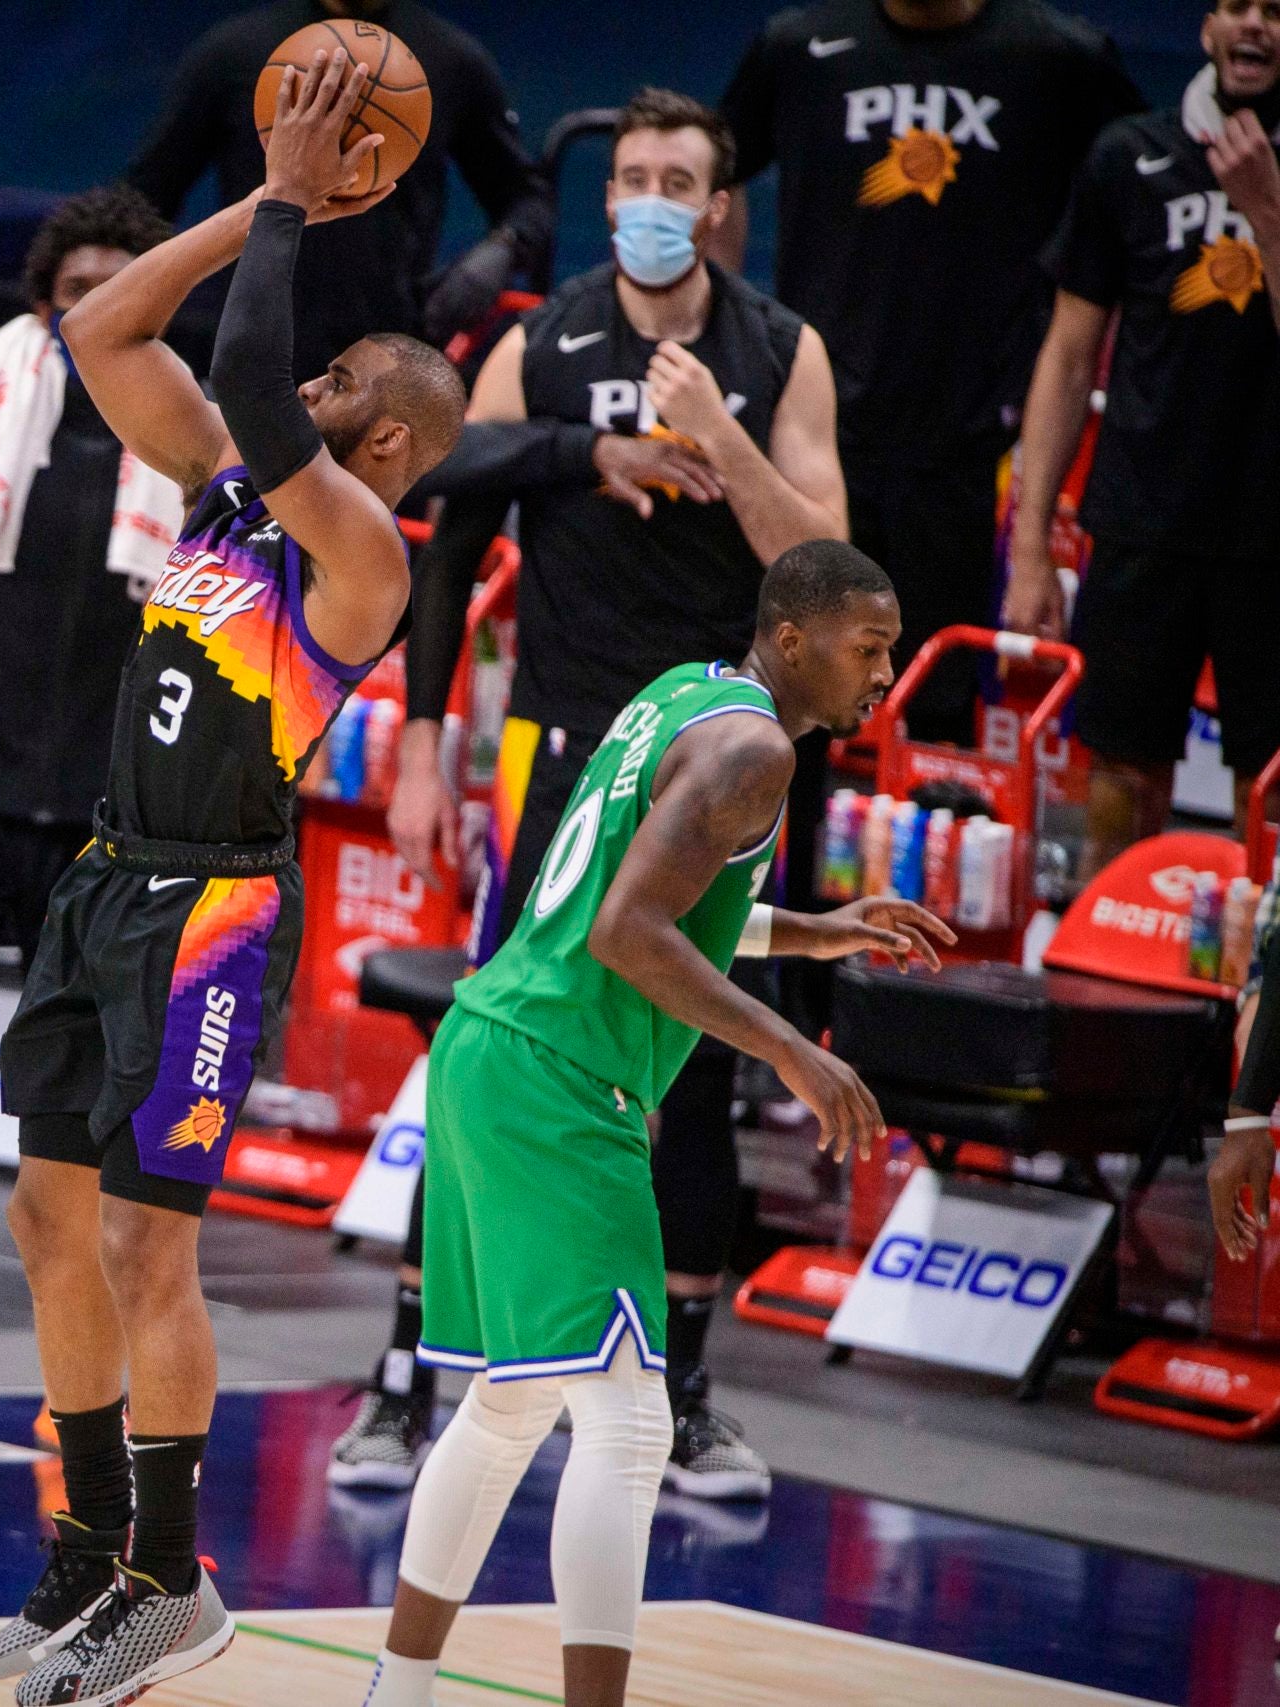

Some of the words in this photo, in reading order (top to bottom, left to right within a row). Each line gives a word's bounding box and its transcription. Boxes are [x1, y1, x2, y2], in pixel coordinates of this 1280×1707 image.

[843, 83, 1001, 152] PHX
[1164, 190, 1255, 252] PH
[168, 550, 194, 567] THE
[248, 531, 281, 541] PayPal
[149, 668, 193, 745] 3
[192, 985, 236, 1092] SUNS
[870, 1233, 1069, 1308] GEICO
